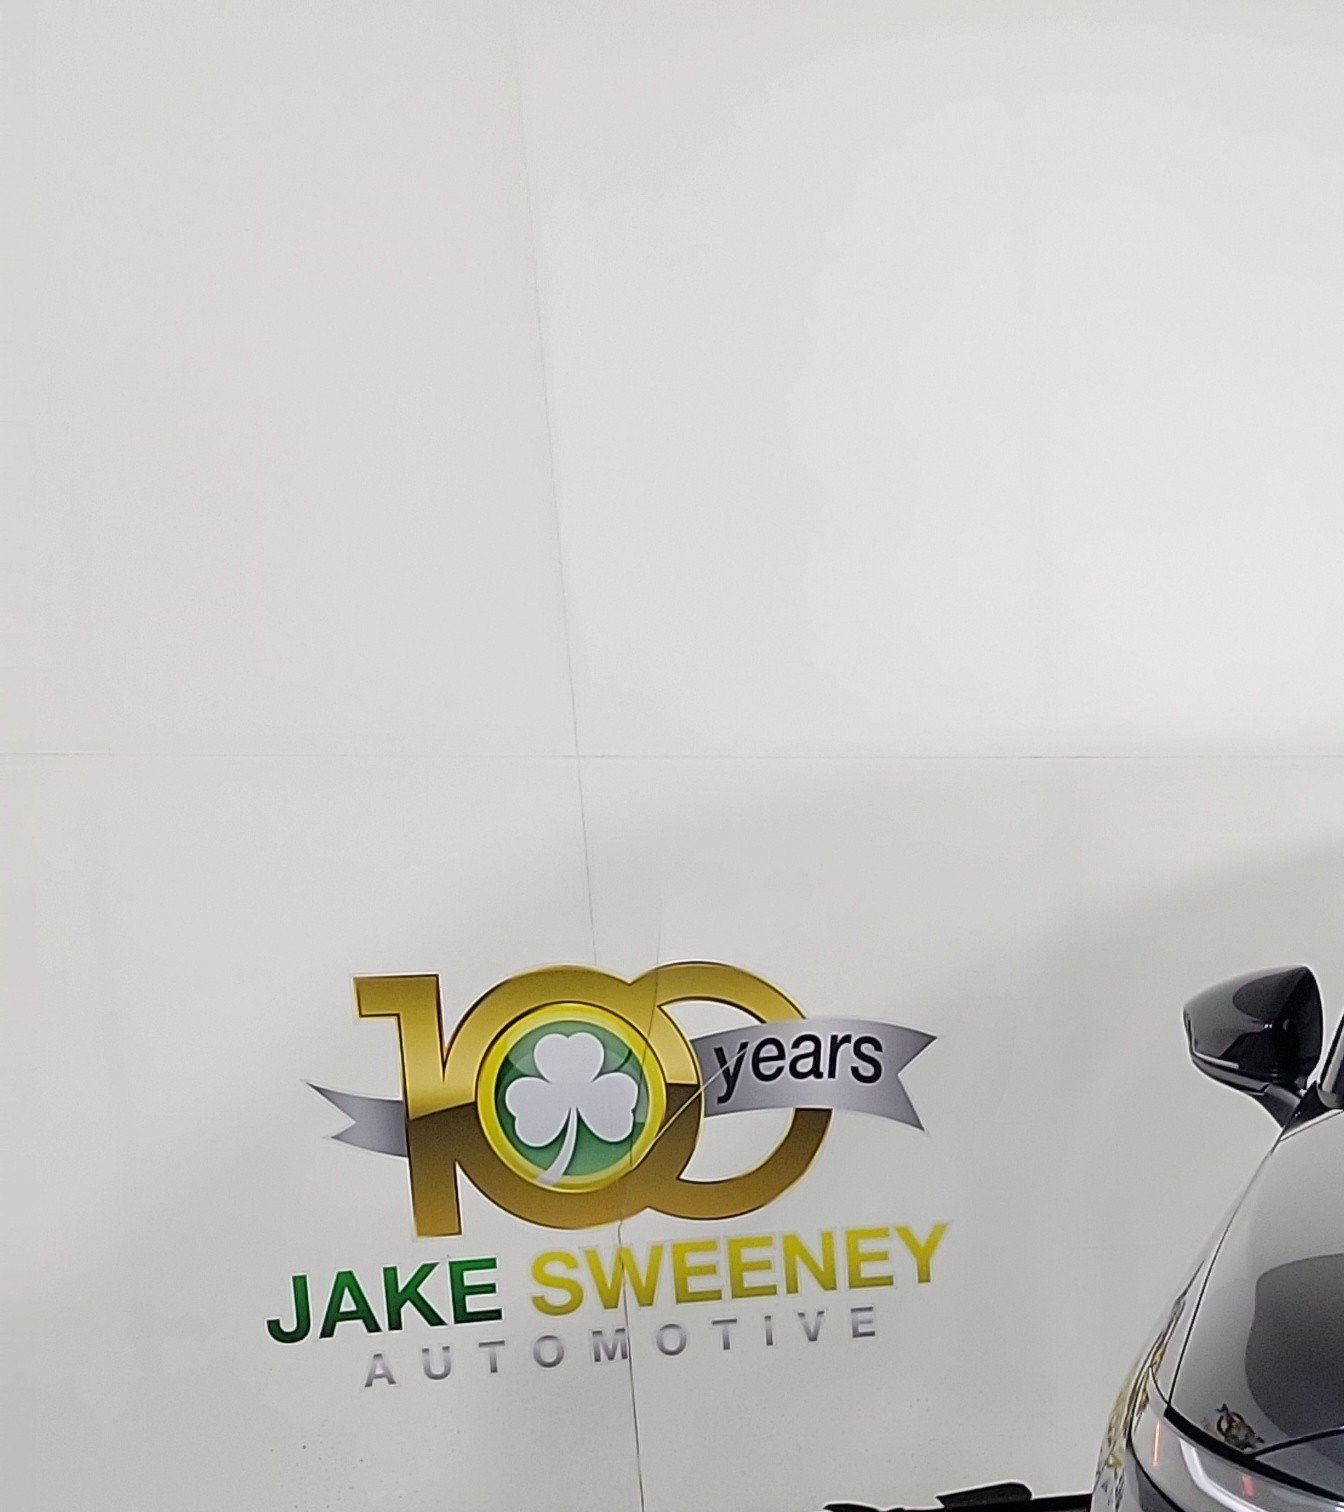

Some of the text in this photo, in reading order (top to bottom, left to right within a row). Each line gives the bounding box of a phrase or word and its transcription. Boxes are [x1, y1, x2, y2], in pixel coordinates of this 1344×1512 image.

[353, 961, 882, 1236] 100 years
[267, 1223, 947, 1344] JAKE SWEENEY
[364, 1307, 877, 1388] AUTOMOTIVE
